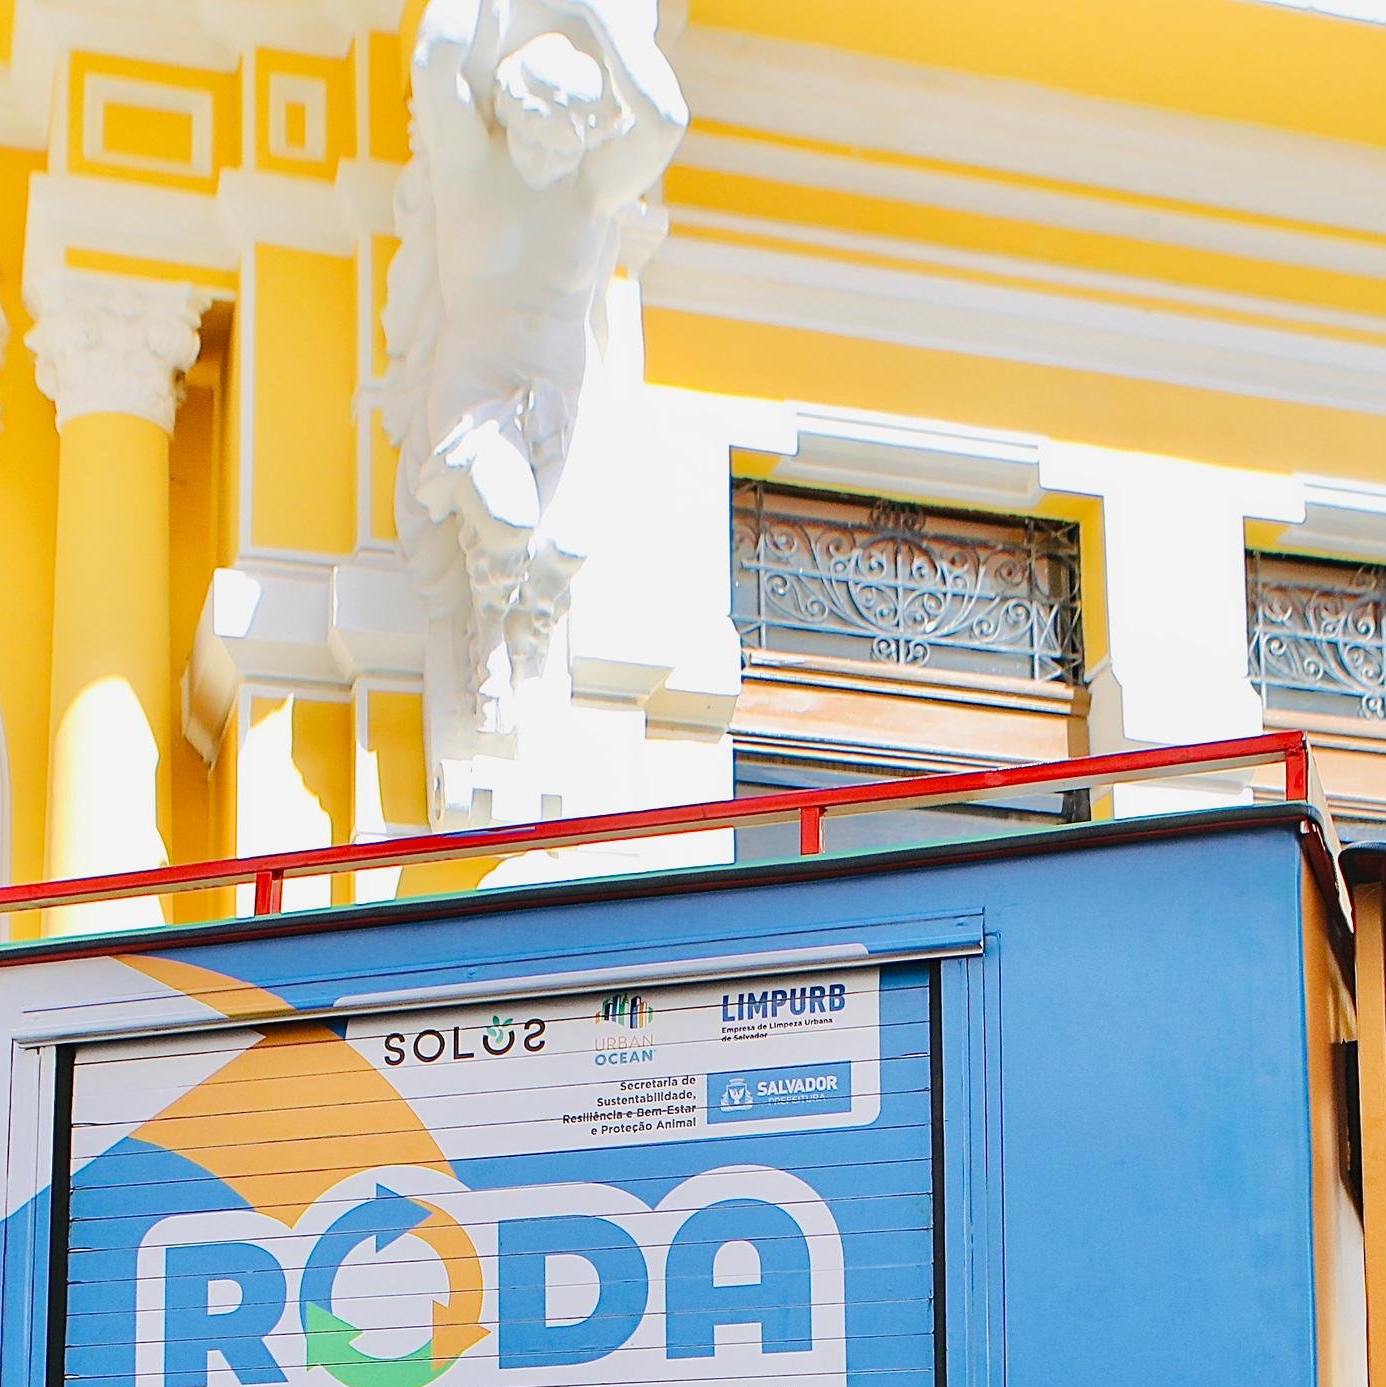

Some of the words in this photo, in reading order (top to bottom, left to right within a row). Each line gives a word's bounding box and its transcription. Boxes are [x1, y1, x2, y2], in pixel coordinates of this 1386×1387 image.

[722, 984, 846, 1022] LIMPURB
[721, 1025, 755, 1036] Empresa
[757, 1023, 767, 1031] de
[769, 1020, 803, 1031] Limpeza
[804, 1018, 833, 1026] Urbana
[595, 1034, 654, 1051] URBAN
[595, 1050, 654, 1067] OCEAN
[620, 1077, 678, 1091] Secretaria
[682, 1075, 696, 1085] de
[757, 1075, 838, 1097] SALVADOR
[597, 1090, 696, 1107] Sustentabilidade,
[626, 1110, 633, 1119] e
[636, 1104, 696, 1118] Bem-Estar
[590, 1127, 598, 1136] e
[601, 1121, 653, 1135] Proteção
[656, 1117, 696, 1130] Animal
